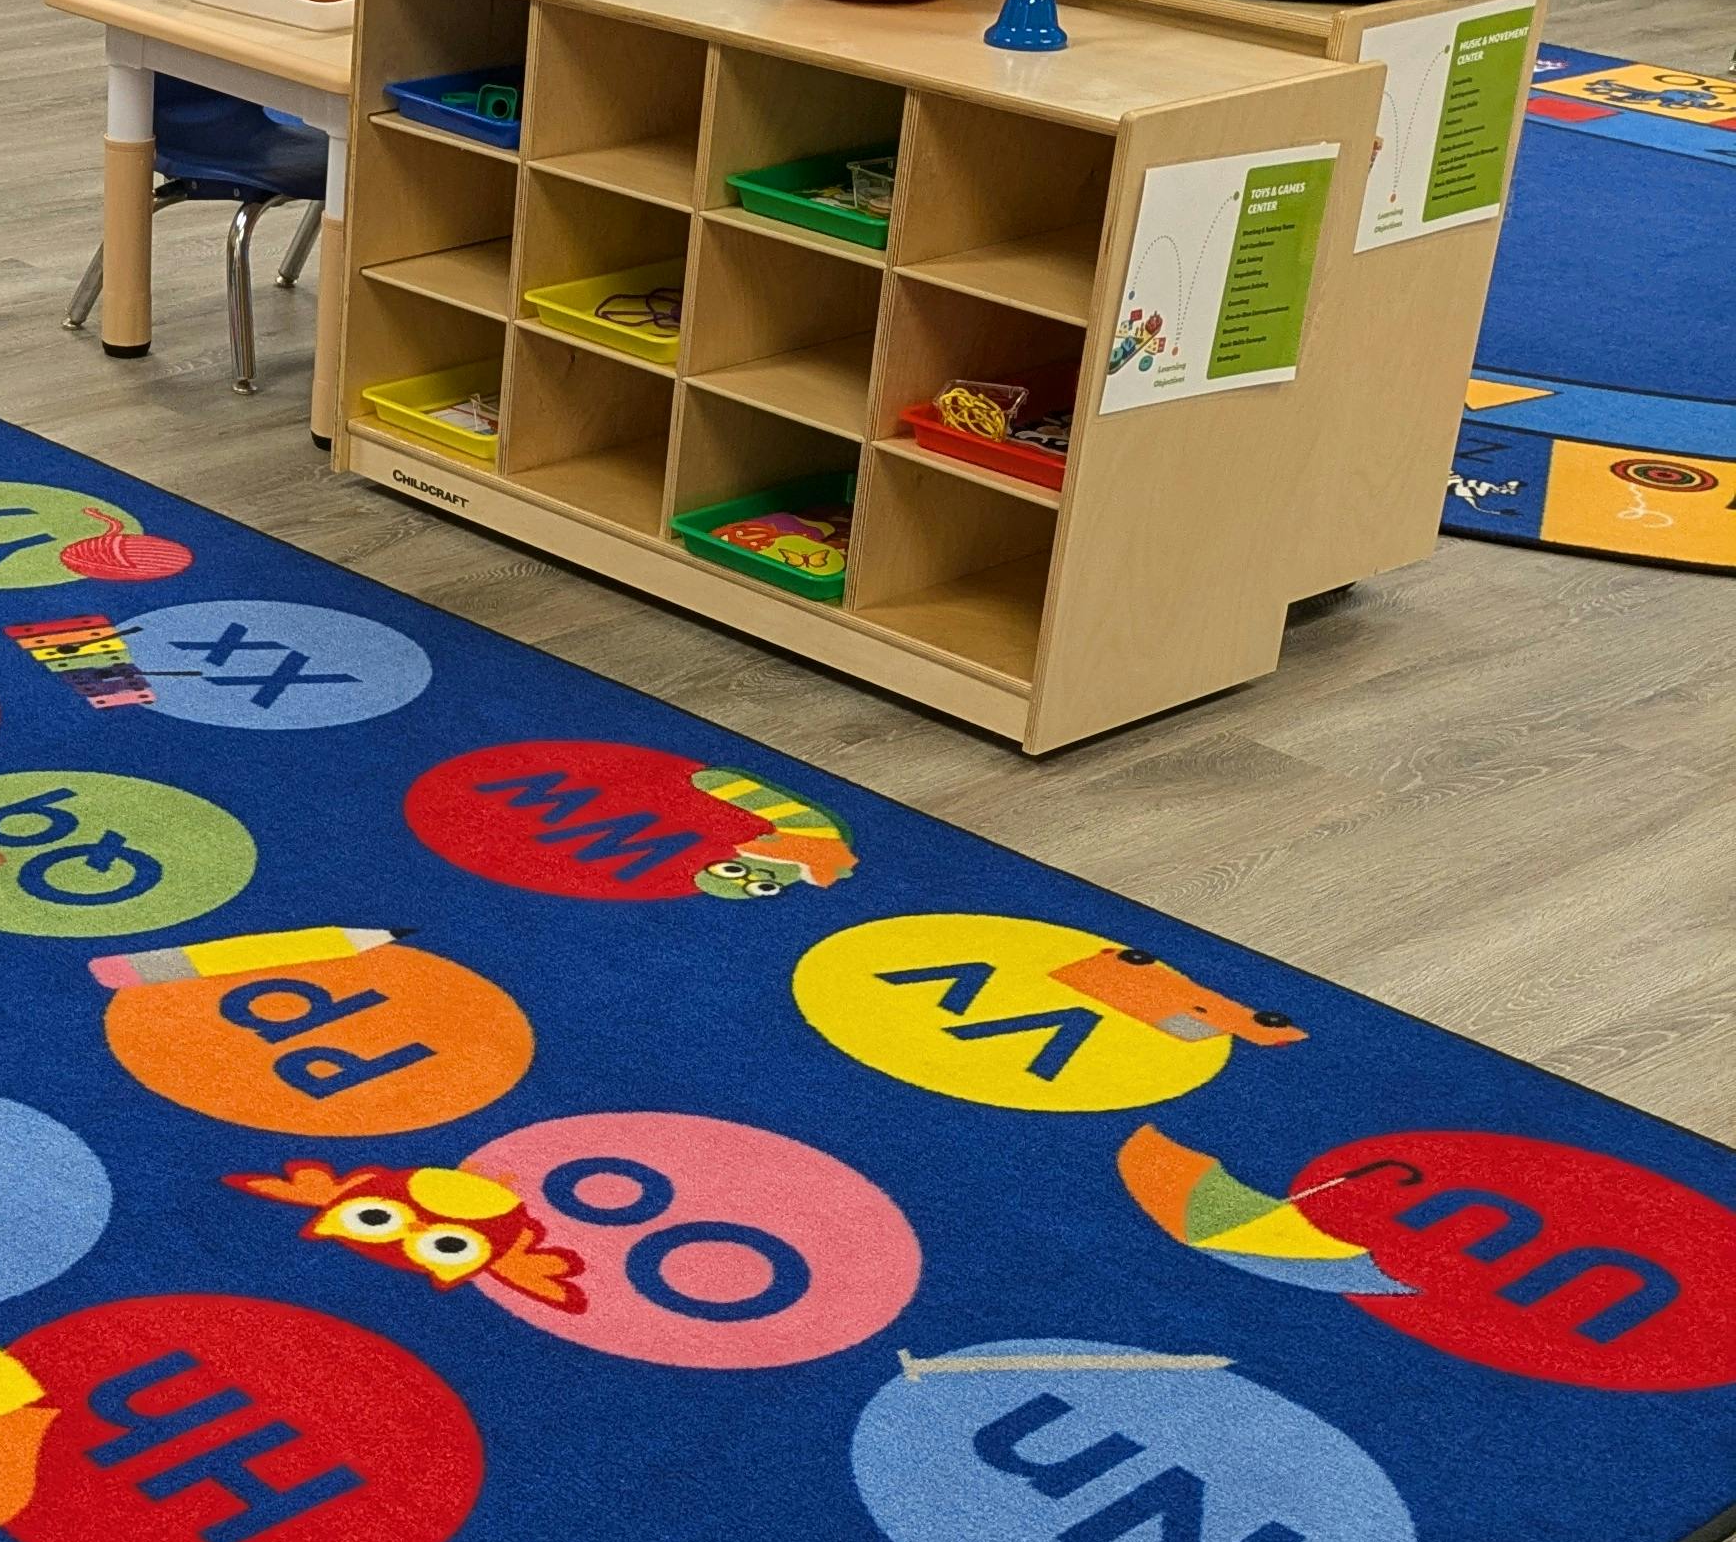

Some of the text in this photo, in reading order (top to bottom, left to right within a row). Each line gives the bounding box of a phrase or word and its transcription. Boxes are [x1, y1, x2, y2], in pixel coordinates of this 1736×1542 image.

[1457, 51, 1484, 66] CENTER
[1459, 36, 1482, 52] MUSIC
[1488, 26, 1530, 45] MOVEMENT
[1247, 201, 1278, 215] CENTER
[1251, 187, 1272, 200] TOYS
[1277, 182, 1306, 195] GAMES
[392, 469, 470, 508] CHILDCRAFT
[168, 621, 363, 710] Xx
[473, 770, 709, 882] Ww
[218, 977, 438, 1100] Pp
[874, 961, 1103, 1083] Vv
[540, 1156, 812, 1323] Oo
[1393, 1187, 1682, 1347] Uu
